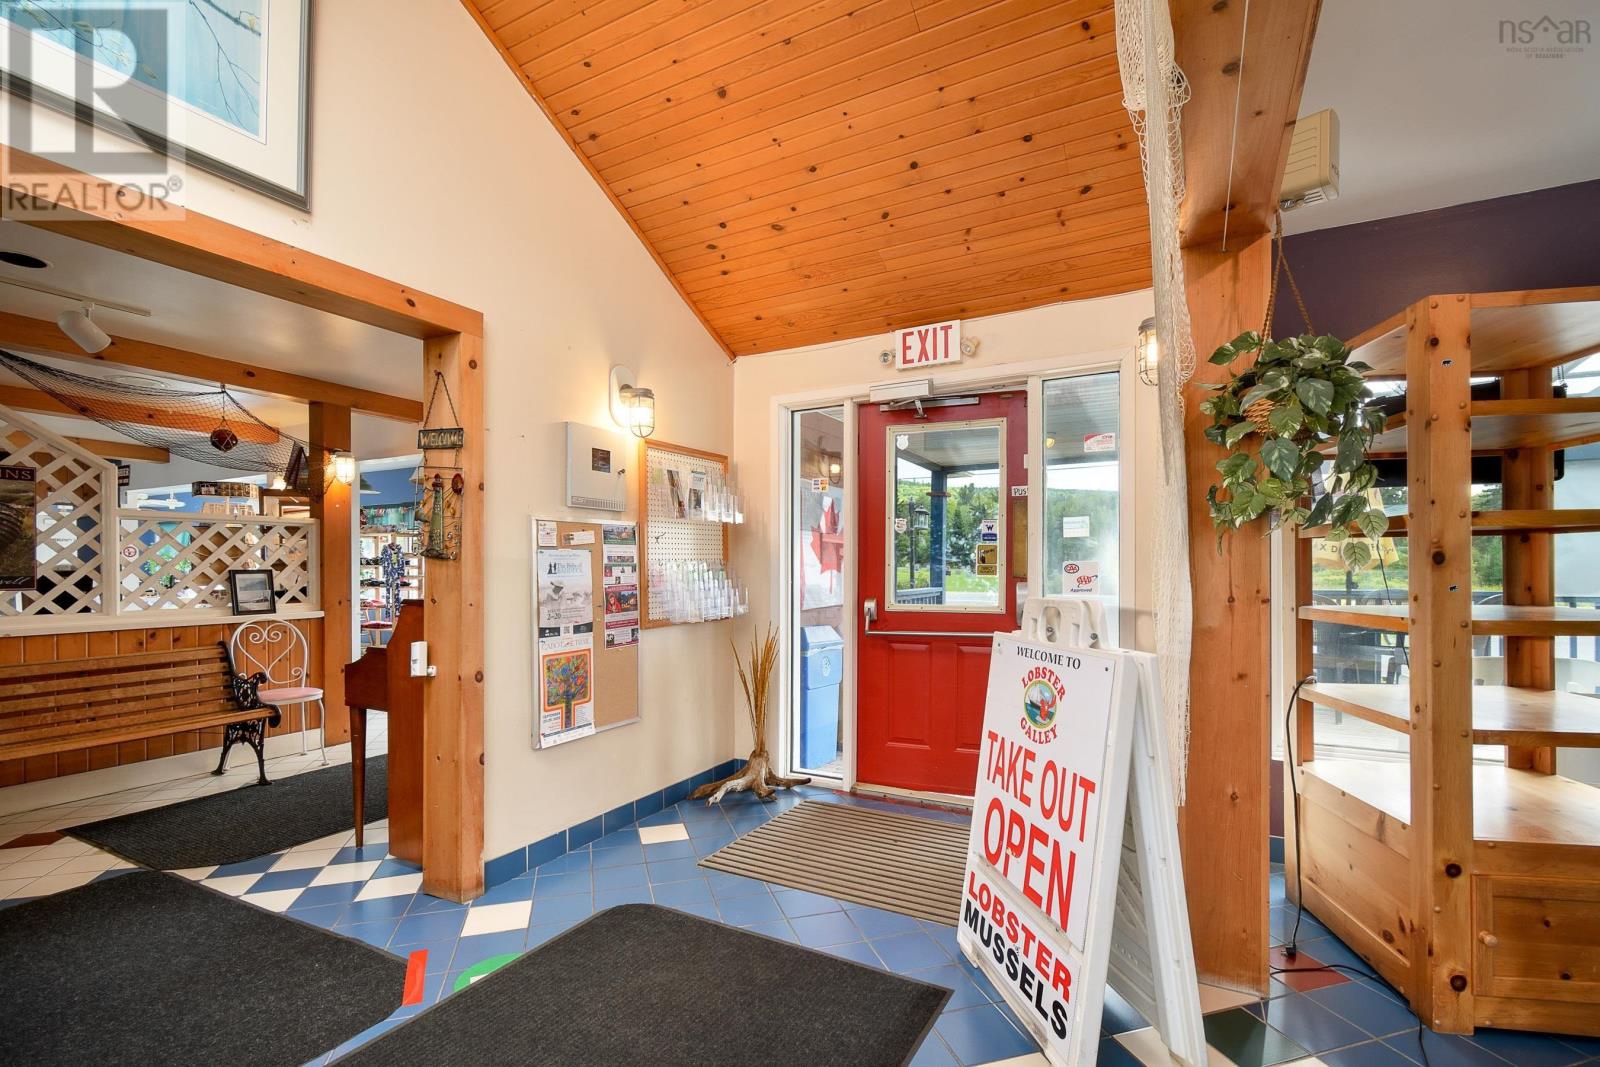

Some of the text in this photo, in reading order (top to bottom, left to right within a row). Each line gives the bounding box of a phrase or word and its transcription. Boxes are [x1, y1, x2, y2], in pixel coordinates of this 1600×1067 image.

[902, 325, 953, 365] EXIT
[420, 431, 463, 446] WELCOME
[1013, 487, 1029, 496] PUS
[1017, 646, 1081, 669] WELCOME TO
[1021, 667, 1066, 702] LOBSTER
[1020, 716, 1058, 745] GALLEY
[987, 730, 1096, 842] TAKE OUT
[983, 798, 1077, 933] OPEN
[967, 871, 1072, 1003] LOBSTER
[963, 898, 1068, 1041] MUSSELS
